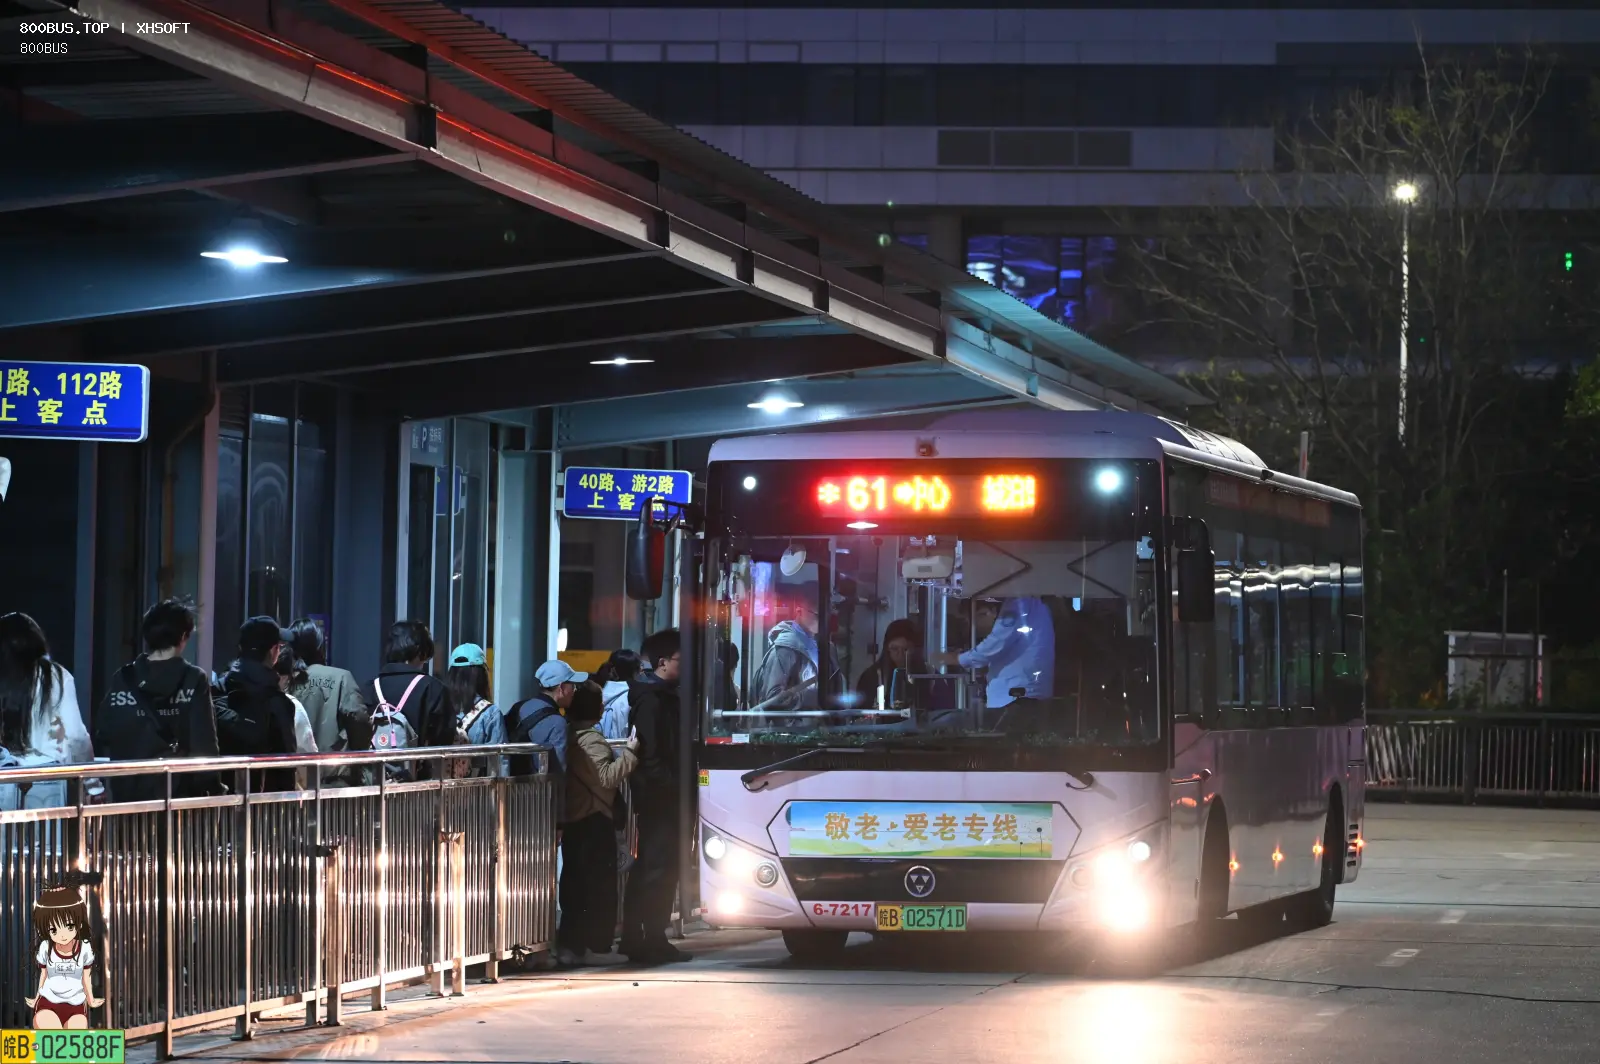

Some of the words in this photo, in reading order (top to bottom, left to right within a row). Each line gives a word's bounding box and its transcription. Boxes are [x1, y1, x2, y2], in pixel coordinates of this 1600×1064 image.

[0, 367, 122, 399] 路、112路
[579, 472, 675, 495] 40路、游2路
[846, 475, 887, 511] 61
[824, 812, 880, 841] 敬老
[903, 812, 1019, 842] 爱老专线
[813, 903, 872, 917] 6-7217
